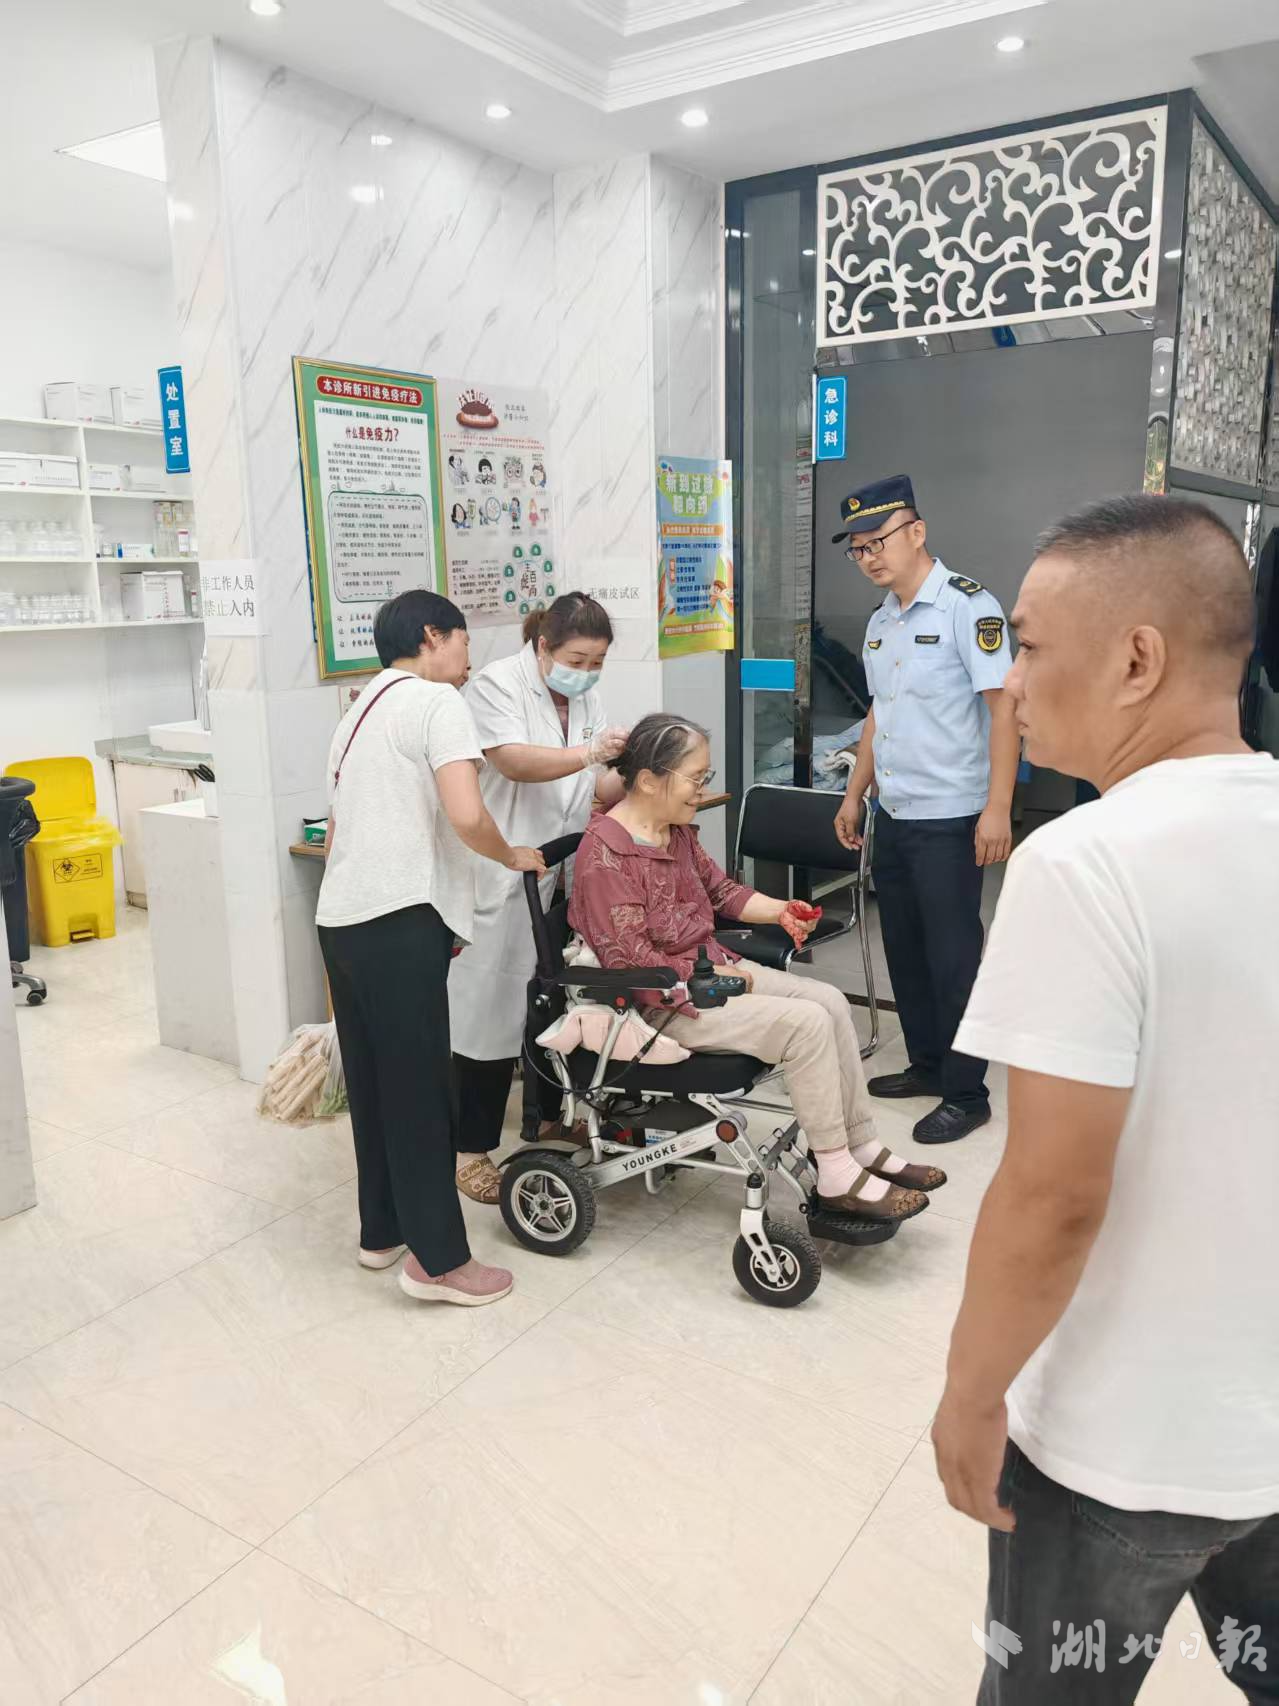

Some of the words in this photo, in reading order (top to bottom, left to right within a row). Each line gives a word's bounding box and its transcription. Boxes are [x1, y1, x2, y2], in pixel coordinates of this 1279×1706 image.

[323, 379, 418, 404] 本诊所新引进免疫疗法
[165, 382, 184, 456] 处置室
[823, 387, 839, 447] 急诊科
[622, 1144, 678, 1171] YOUNGKE
